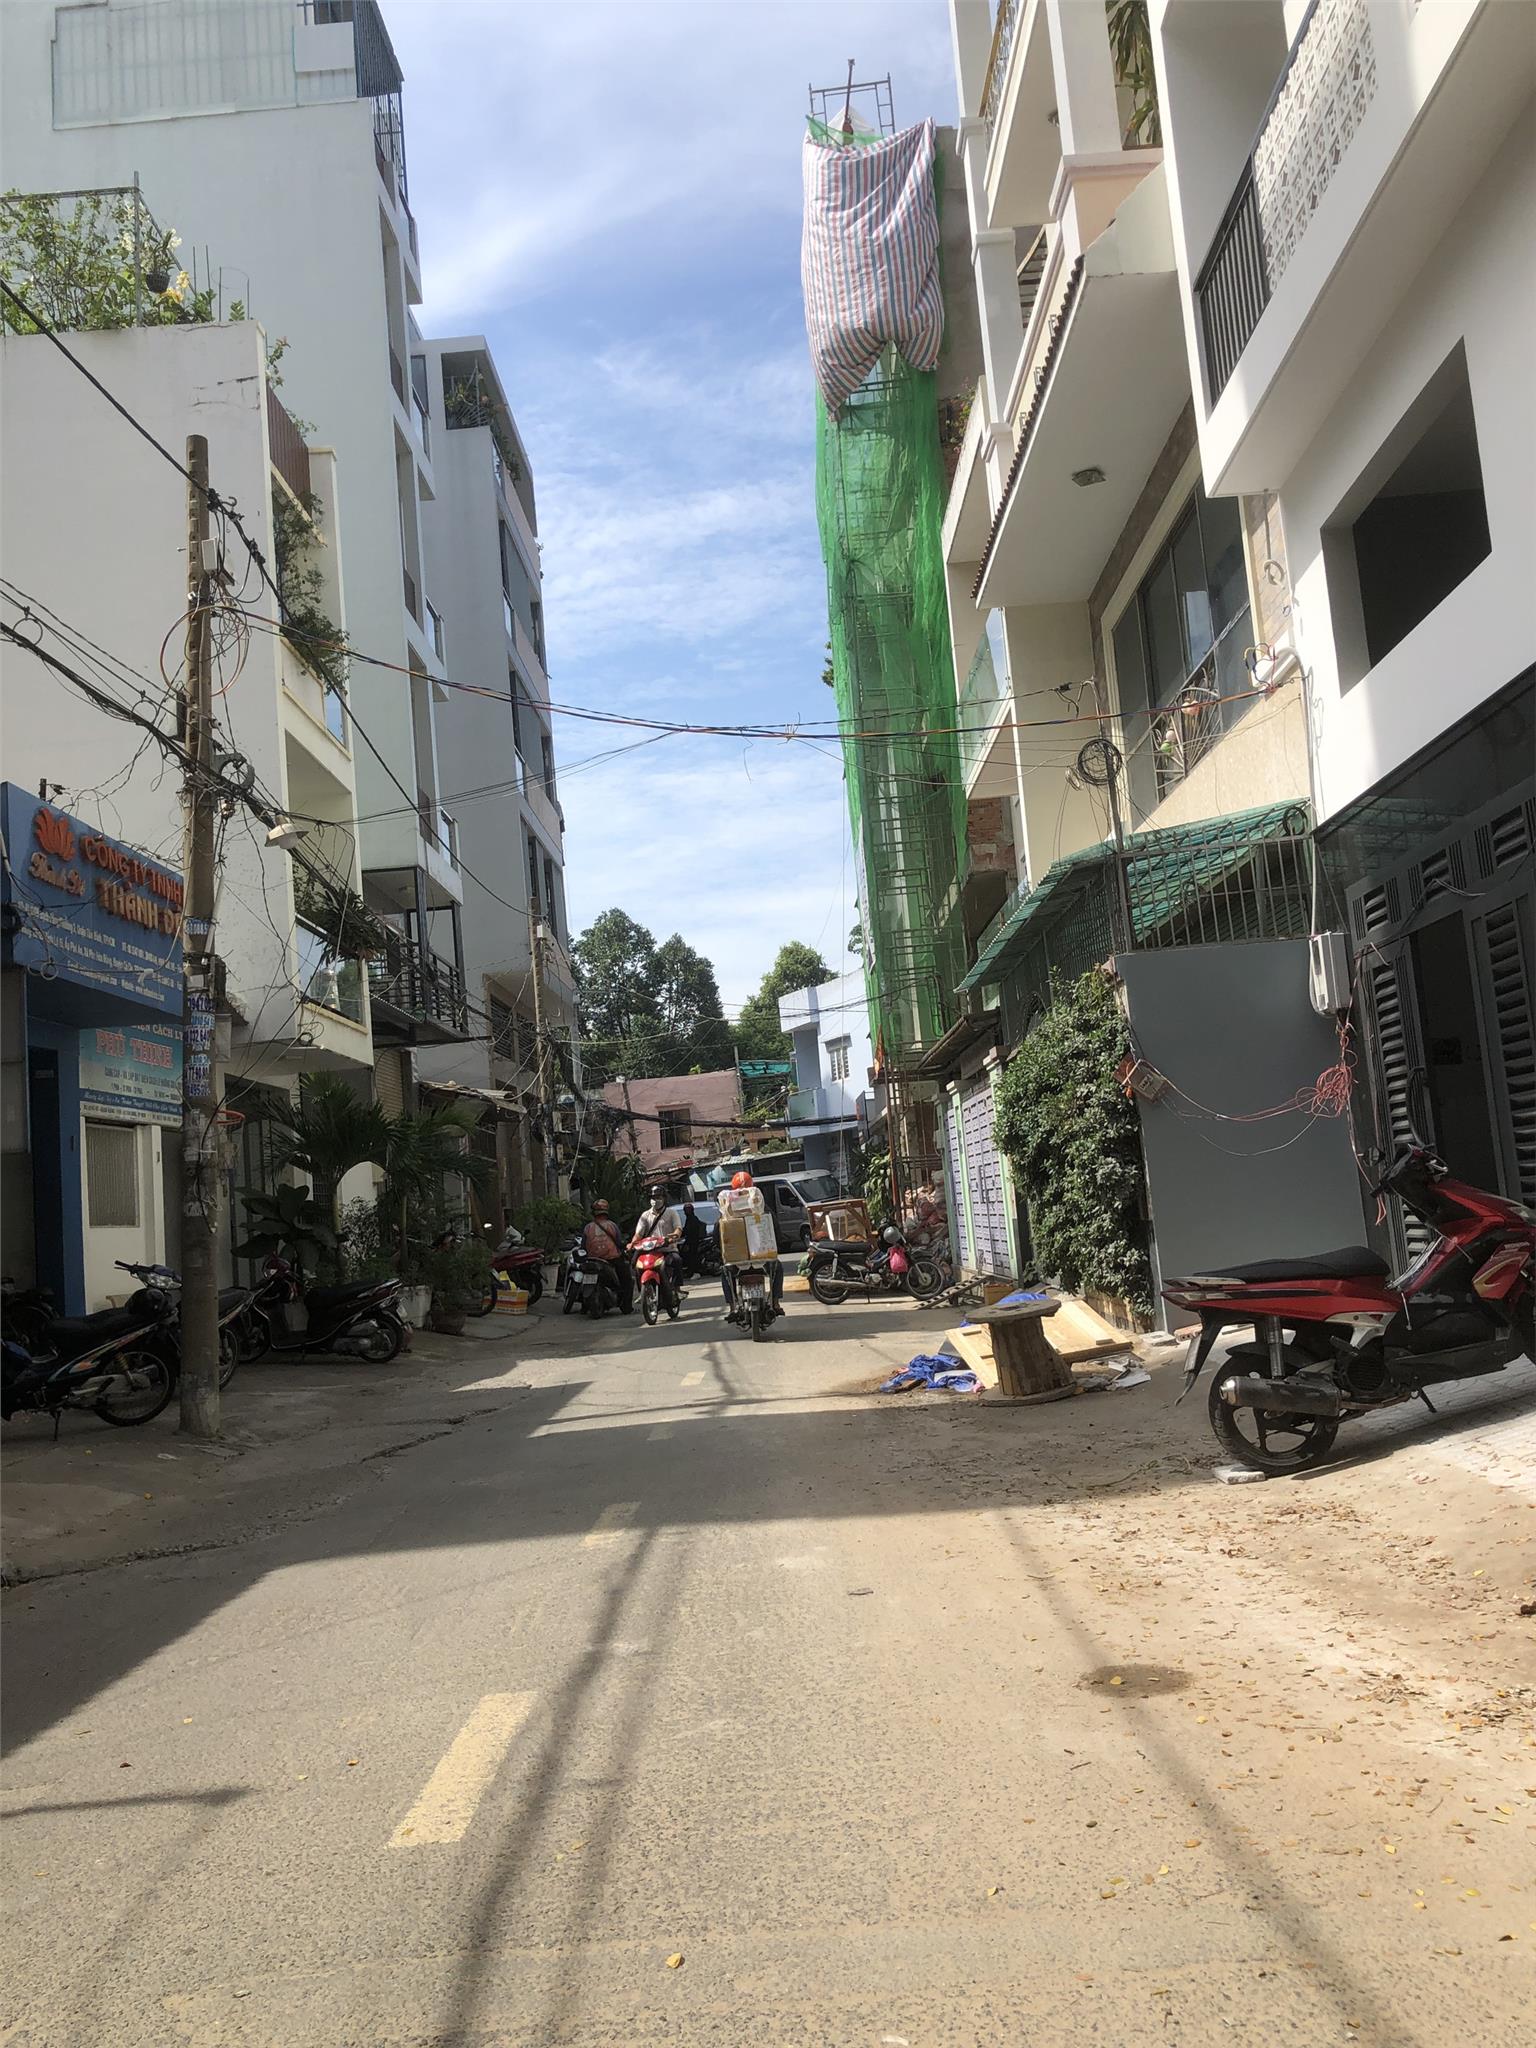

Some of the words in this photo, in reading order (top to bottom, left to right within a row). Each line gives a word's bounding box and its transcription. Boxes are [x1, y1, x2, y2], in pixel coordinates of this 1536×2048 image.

[83, 836, 130, 876] CÔNG
[133, 858, 147, 885] TY
[99, 879, 159, 930] THÀNH
[96, 1028, 125, 1057] PHÚ
[152, 1024, 173, 1039] CÁCH
